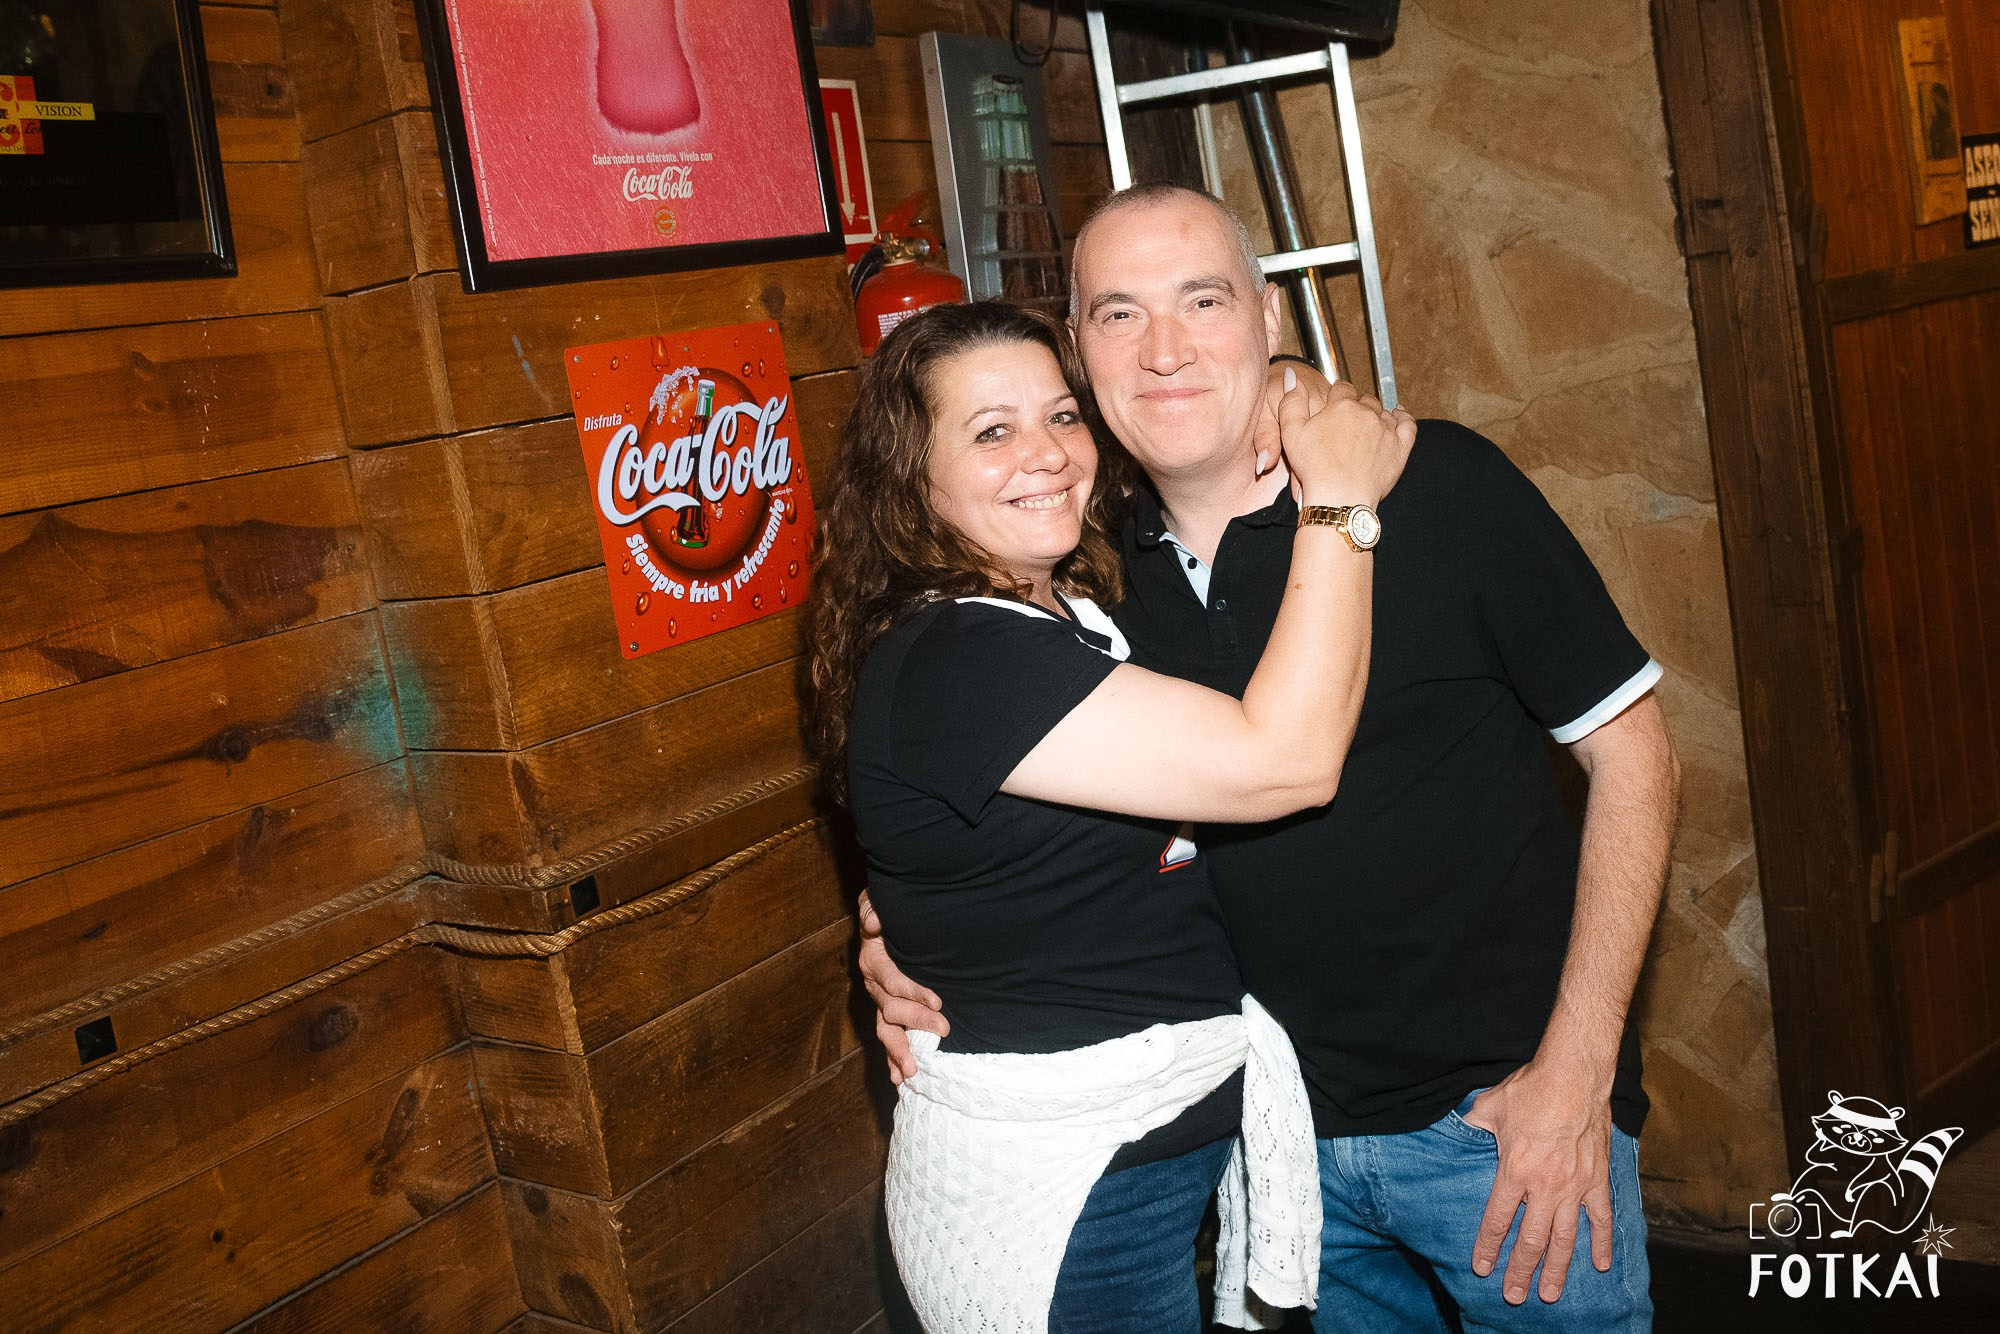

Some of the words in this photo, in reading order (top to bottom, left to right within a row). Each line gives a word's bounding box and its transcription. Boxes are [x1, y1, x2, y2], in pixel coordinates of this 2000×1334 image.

[35, 104, 82, 117] VISION
[592, 154, 611, 166] Cada
[612, 153, 635, 165] noche
[636, 154, 645, 163] es
[646, 152, 680, 164] diferente.
[700, 152, 713, 162] con
[622, 165, 694, 202] Coca-Cola
[583, 412, 623, 432] Disfruta
[597, 393, 793, 526] Coca-Cola
[625, 533, 685, 600] Siempre
[721, 581, 733, 602] y
[734, 498, 786, 590] refrescante
